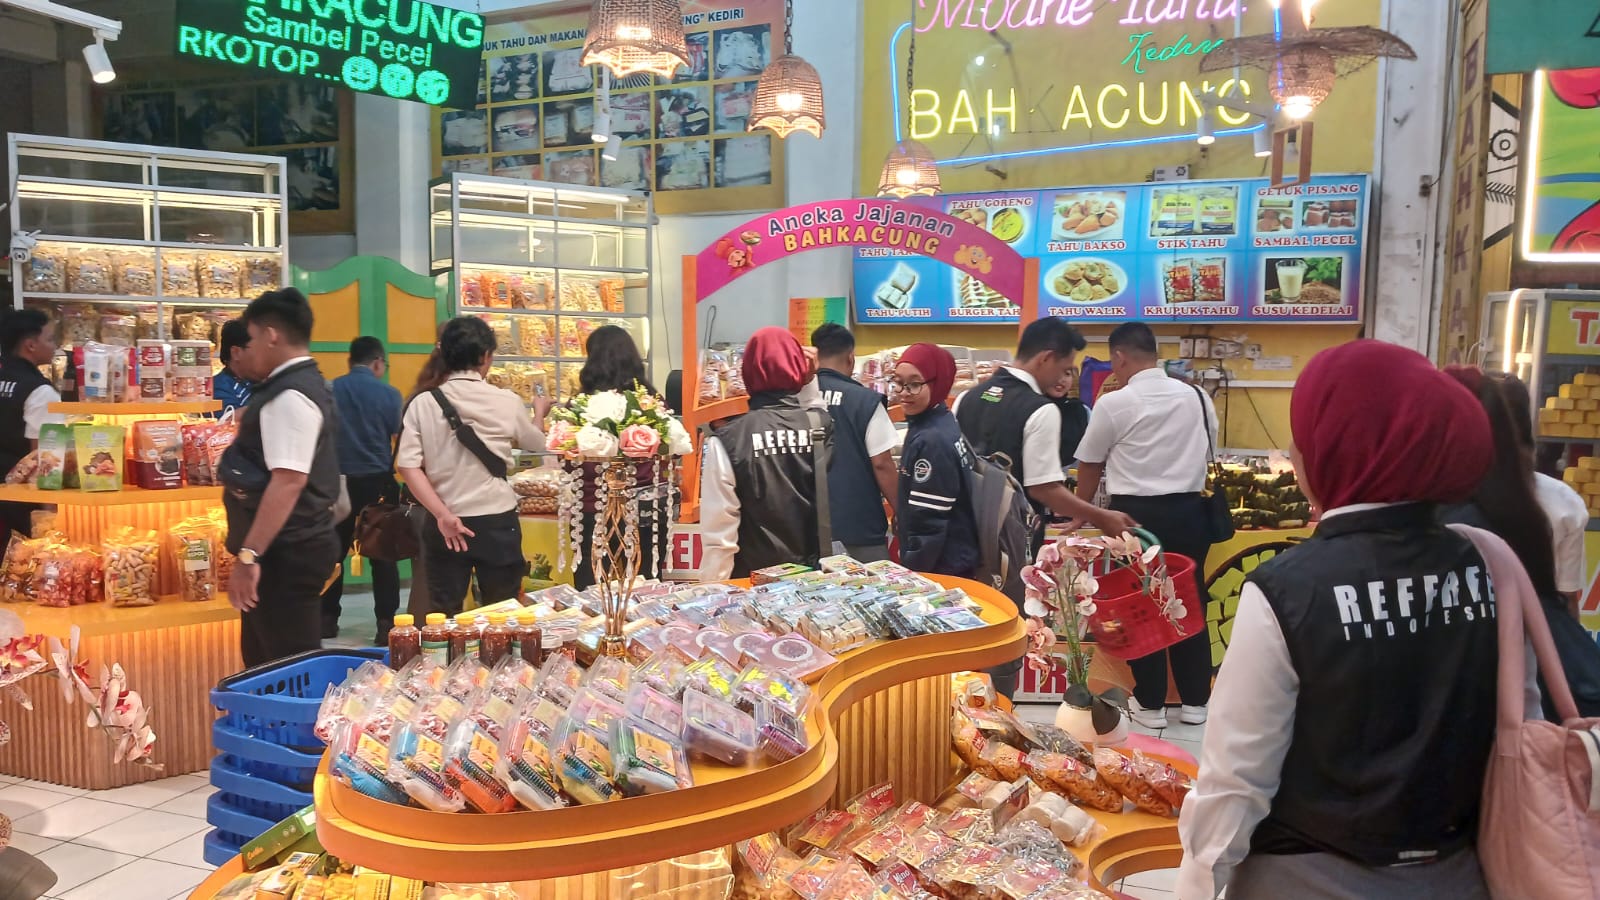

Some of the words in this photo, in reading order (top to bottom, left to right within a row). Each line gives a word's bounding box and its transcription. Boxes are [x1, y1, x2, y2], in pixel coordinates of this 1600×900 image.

[501, 37, 525, 49] TAHU
[528, 35, 547, 46] DAN
[708, 8, 744, 22] KEDIRI
[244, 5, 351, 51] Sambel
[361, 29, 432, 67] Pecel
[1307, 184, 1358, 194] PISANG
[952, 200, 981, 209] TAHU
[985, 197, 1032, 207] GORENG
[769, 206, 843, 236] Aneka
[855, 203, 955, 237] Jajanan
[784, 225, 940, 255] BAHKACUNG
[1158, 239, 1187, 248] STIK
[1190, 238, 1226, 247] TAHU
[1255, 237, 1309, 246] SAMBAL
[1313, 235, 1356, 244] PECEL
[1048, 242, 1080, 251] TAHU
[1084, 241, 1126, 250] BAKSO
[950, 308, 994, 316] BURGER
[1085, 307, 1124, 315] WALIK
[1146, 306, 1199, 315] KRUPUK
[1203, 305, 1238, 314] TAHU
[1254, 306, 1289, 315] SUSU
[1292, 306, 1352, 315] KEDELAI
[1571, 311, 1600, 346] T
